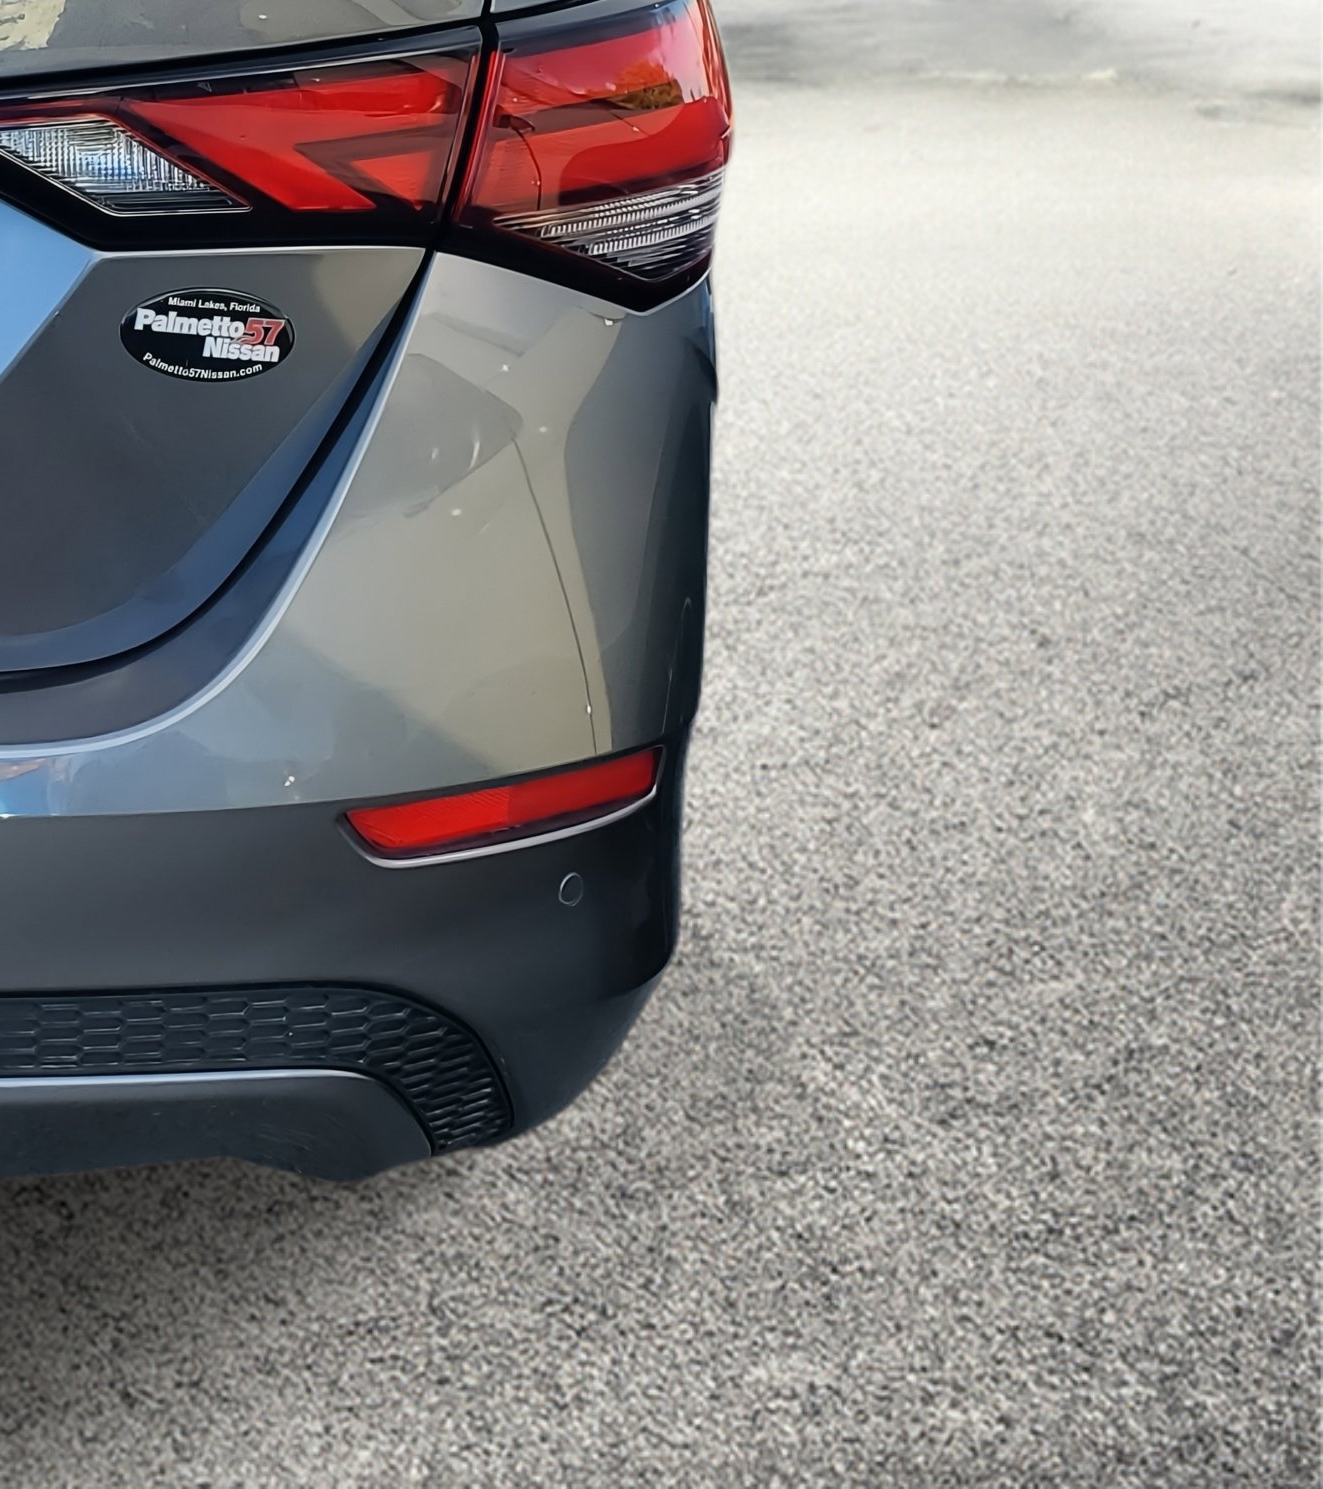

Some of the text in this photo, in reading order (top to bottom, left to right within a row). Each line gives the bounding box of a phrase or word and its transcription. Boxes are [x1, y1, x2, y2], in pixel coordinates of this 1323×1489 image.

[168, 297, 261, 313] Miami Lakes, Florida
[203, 337, 280, 362] Nissan
[143, 352, 263, 379] Palmetto57Nissan.com
